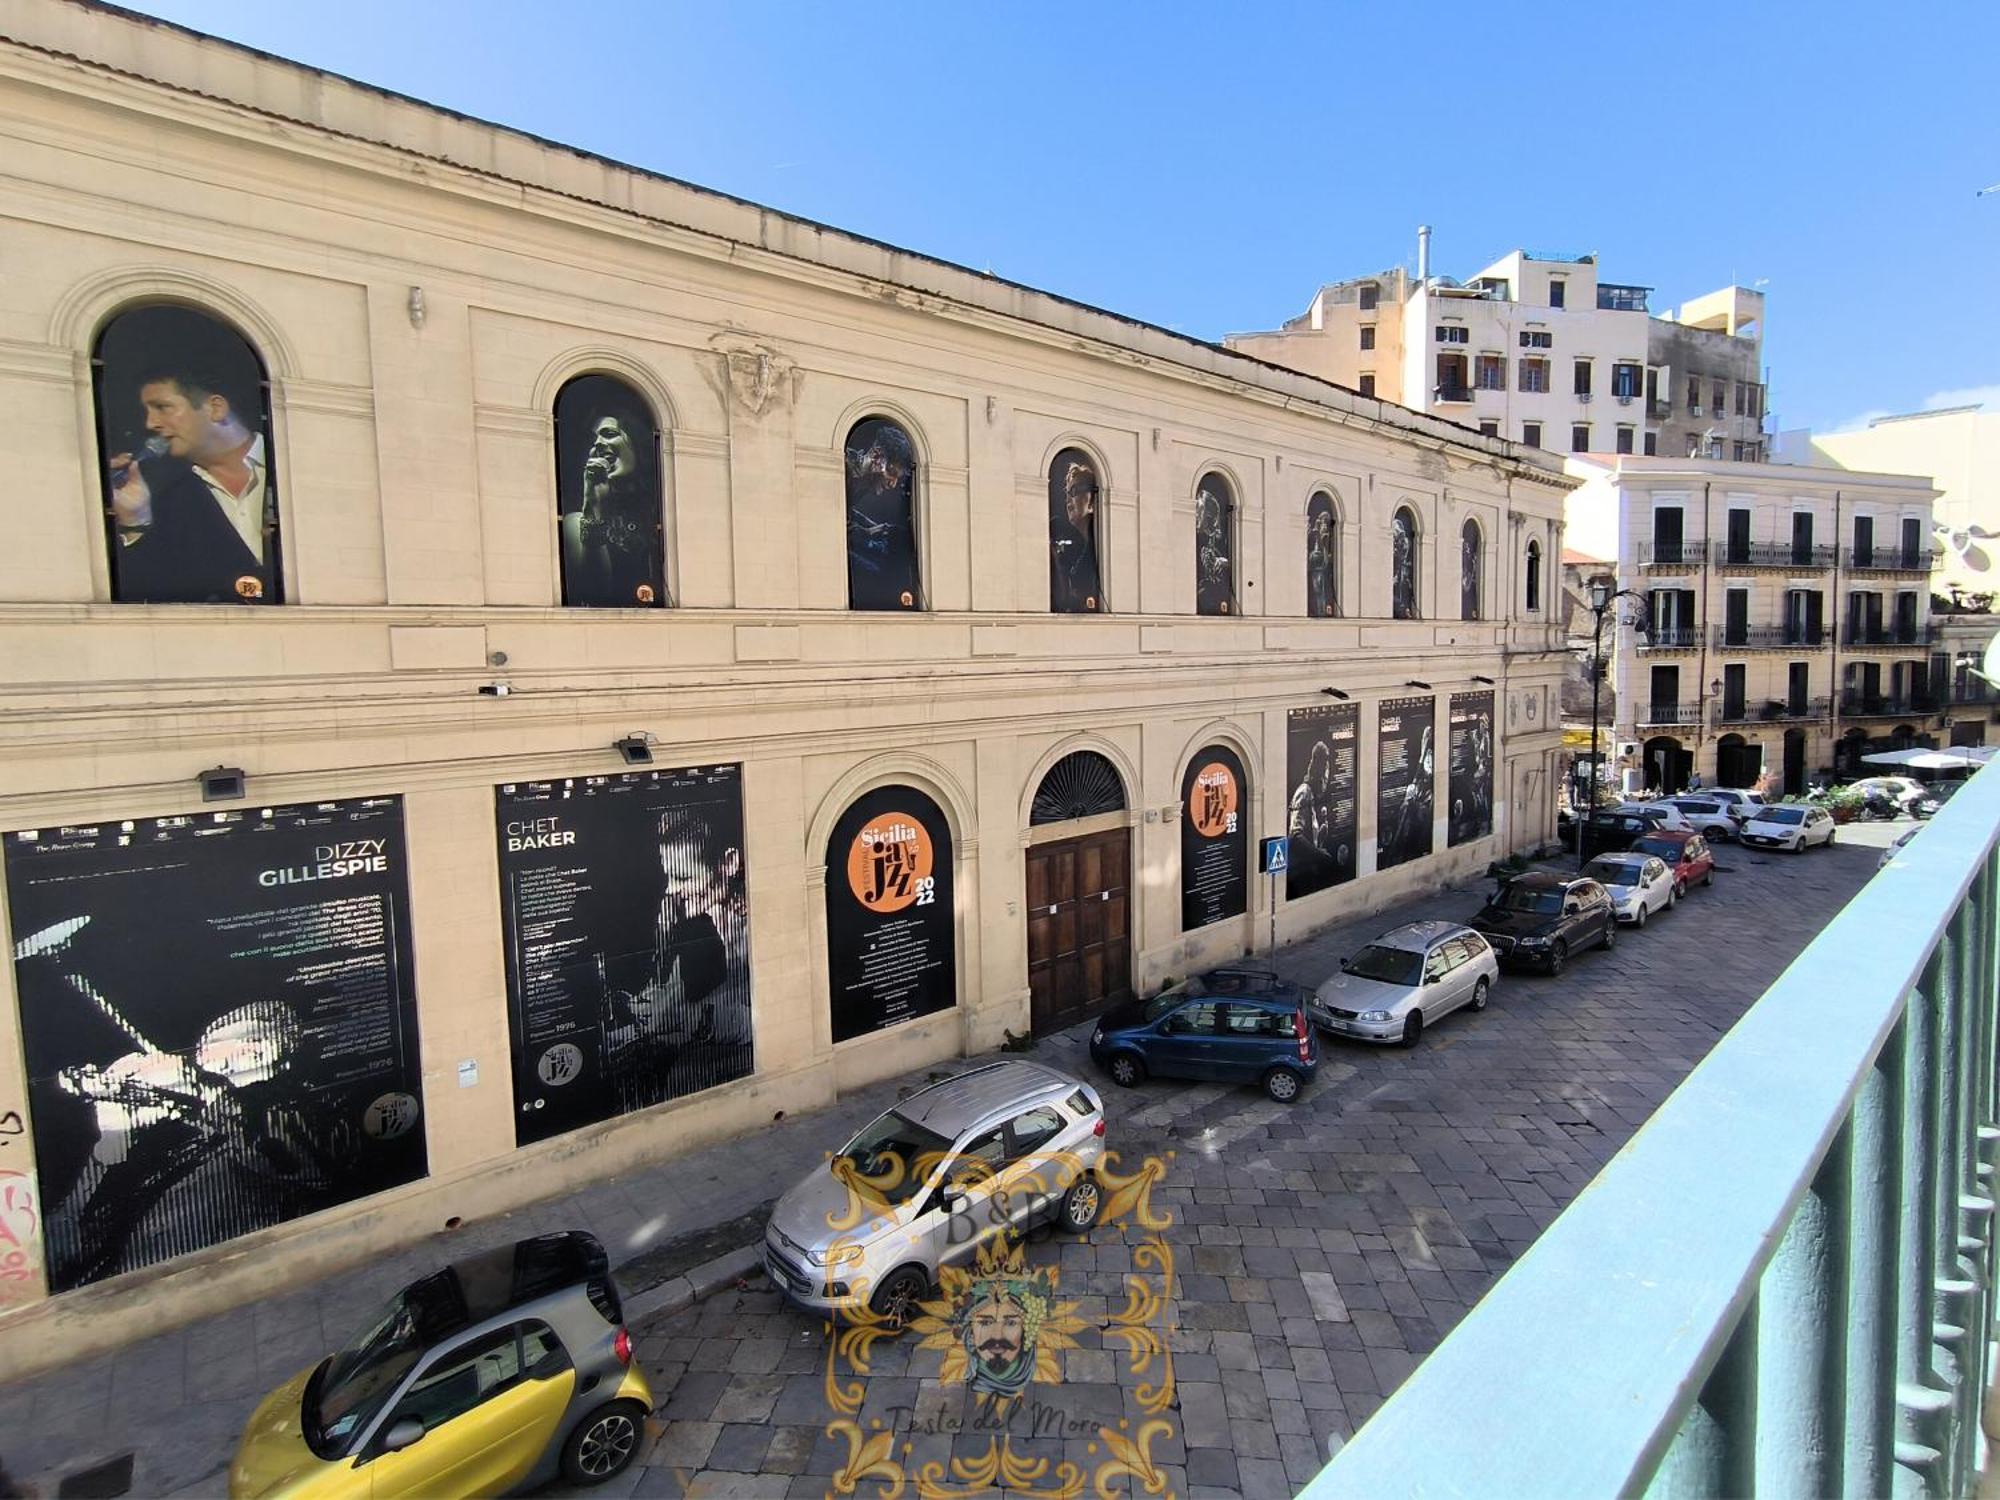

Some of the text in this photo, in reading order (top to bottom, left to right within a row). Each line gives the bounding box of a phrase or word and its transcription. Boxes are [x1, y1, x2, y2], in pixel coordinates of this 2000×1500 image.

[1198, 771, 1228, 788] Sicilia
[506, 816, 559, 836] CHET
[1226, 812, 1237, 823] 20
[861, 823, 917, 848] Sicilia
[1226, 822, 1237, 833] 22
[316, 838, 386, 862] DIZZY
[508, 831, 575, 852] BAKER
[258, 856, 388, 887] GILLESPIE
[915, 876, 935, 893] 20
[916, 890, 935, 906] 22
[556, 1021, 576, 1033] 1976
